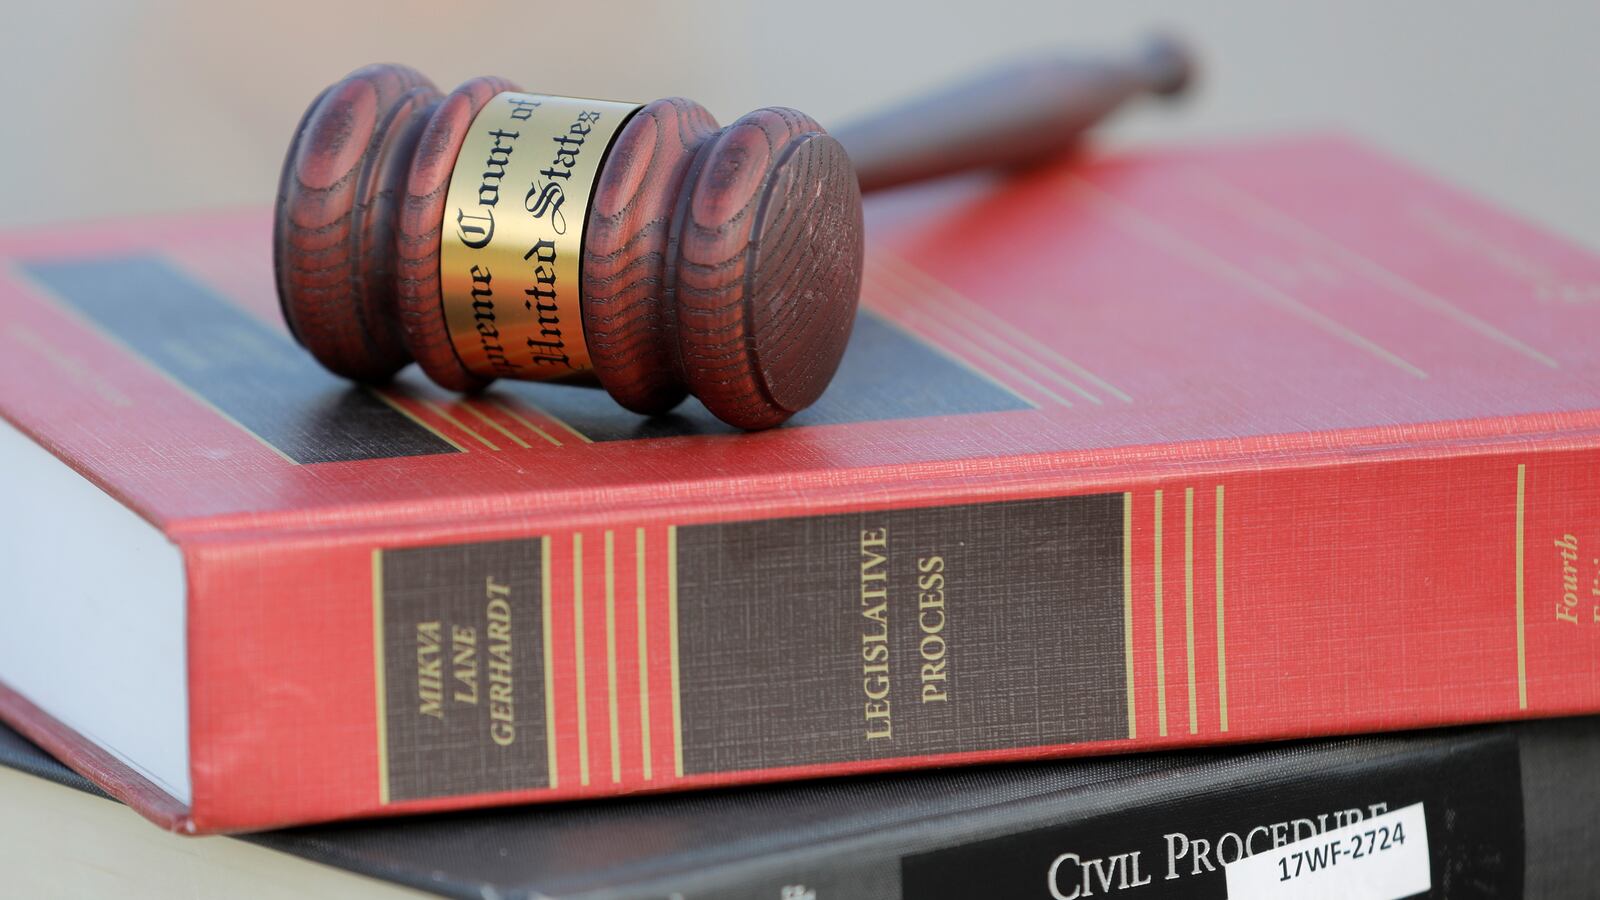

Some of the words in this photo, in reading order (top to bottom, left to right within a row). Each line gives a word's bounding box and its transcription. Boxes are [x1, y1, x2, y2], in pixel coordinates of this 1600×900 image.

[507, 98, 542, 121] of
[456, 129, 520, 249] Court
[525, 111, 601, 235] States
[469, 264, 524, 370] preme
[524, 238, 572, 368] United
[918, 556, 947, 704] PROCESS
[1554, 533, 1578, 624] Fourth
[416, 620, 444, 720] MIKVA
[452, 625, 478, 705] LANE
[486, 576, 516, 746] GERHARDT
[861, 527, 892, 740] LEGISLATIVE
[1047, 850, 1152, 900] CIVIL
[1278, 821, 1406, 882] 17WF-2724
